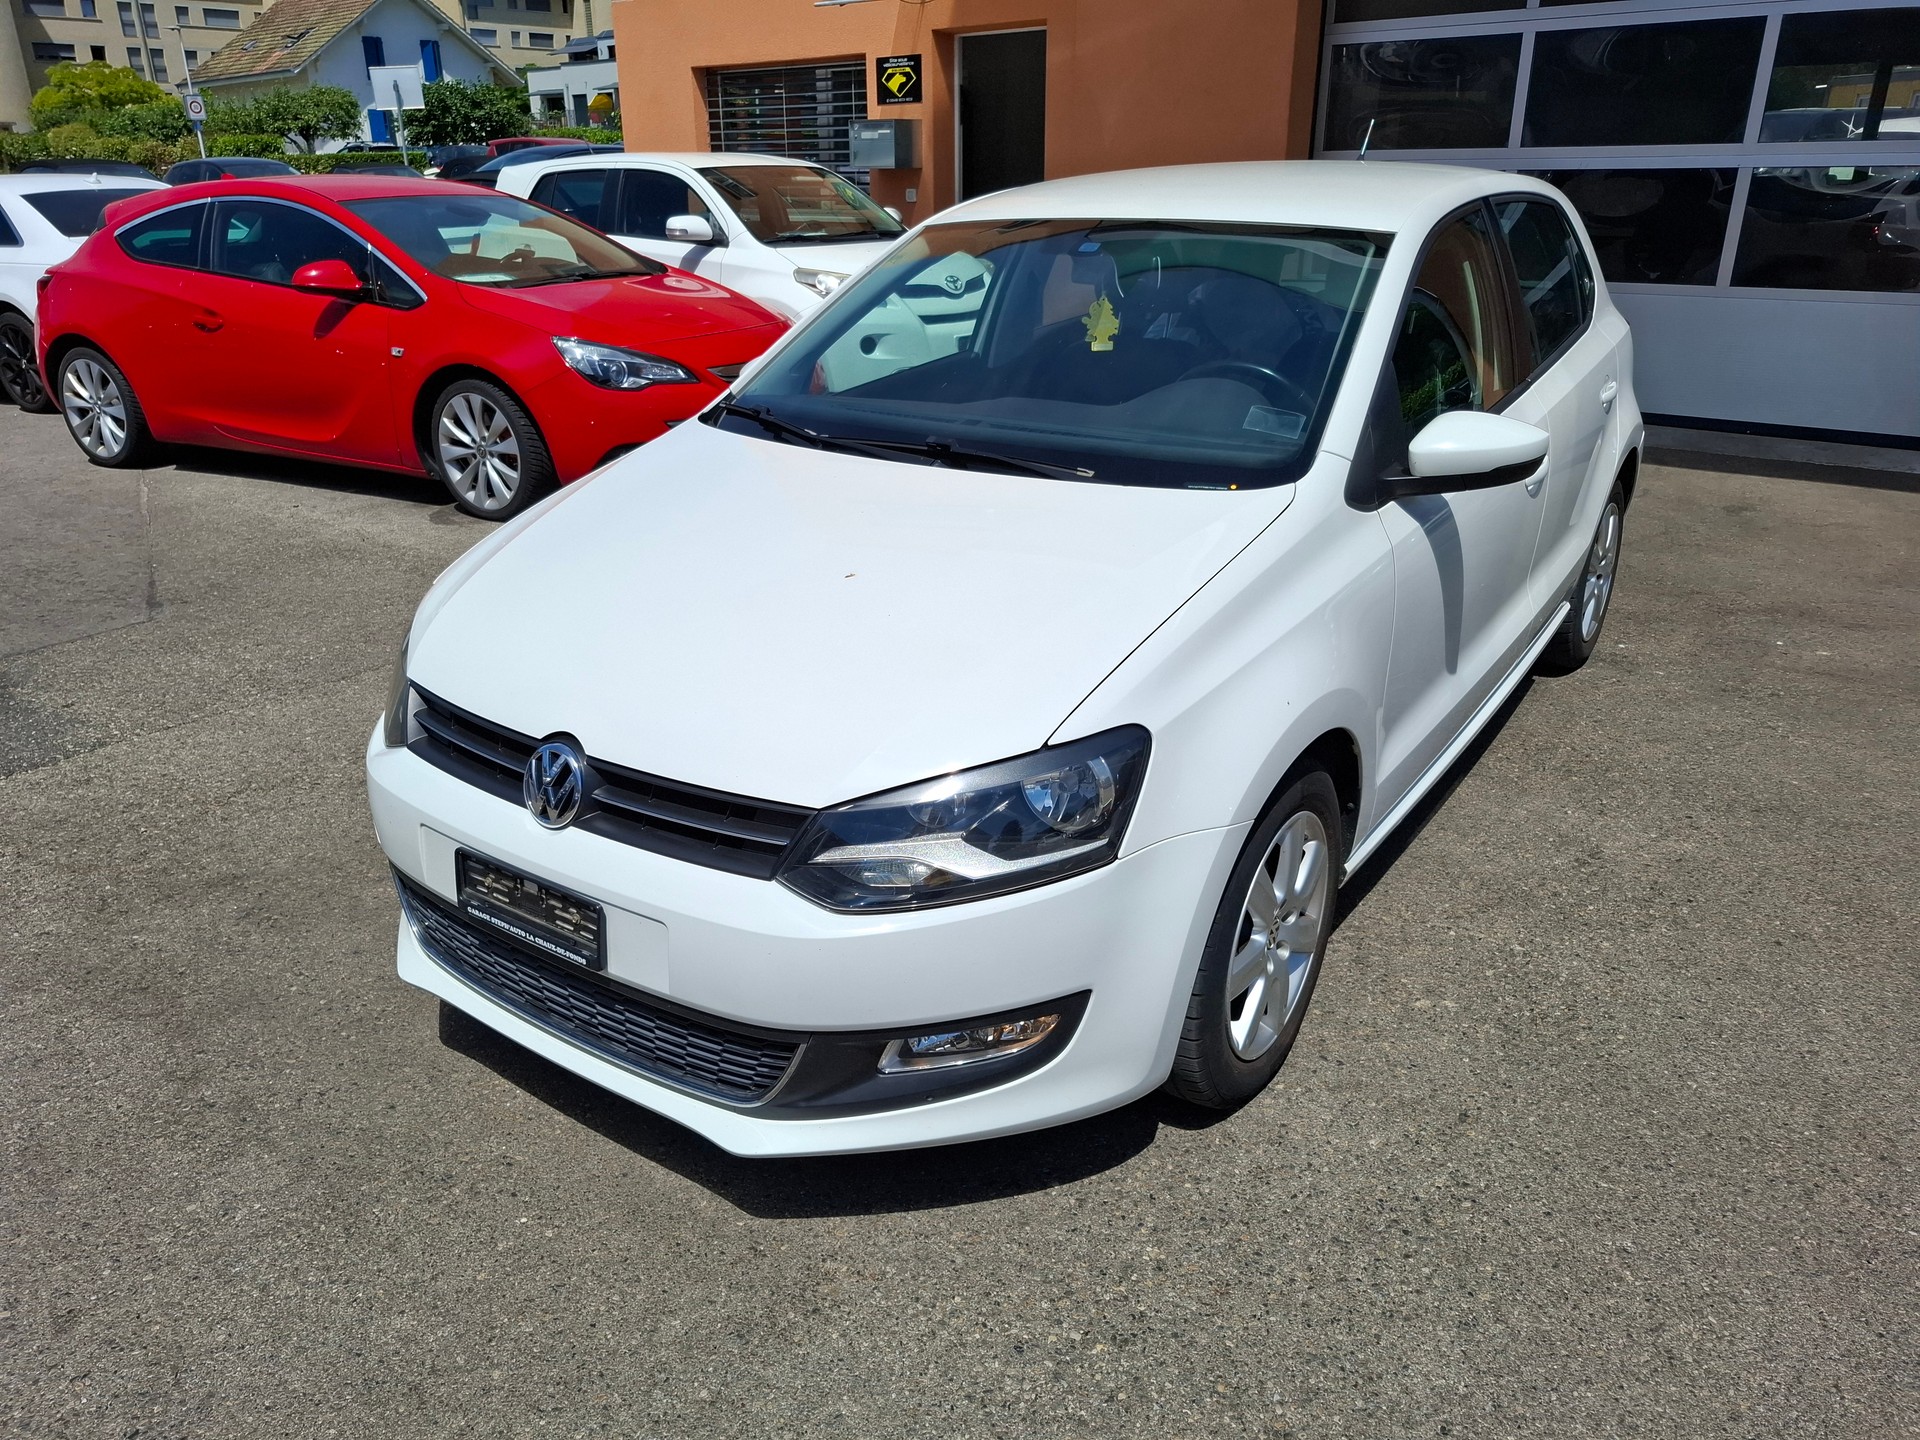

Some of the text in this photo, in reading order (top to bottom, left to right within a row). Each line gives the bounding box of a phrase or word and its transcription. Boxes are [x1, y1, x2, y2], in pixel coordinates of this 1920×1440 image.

[467, 906, 491, 922] GARAGE
[526, 932, 535, 942] LA
[534, 937, 587, 965] CHAUX-DE-FONDS
